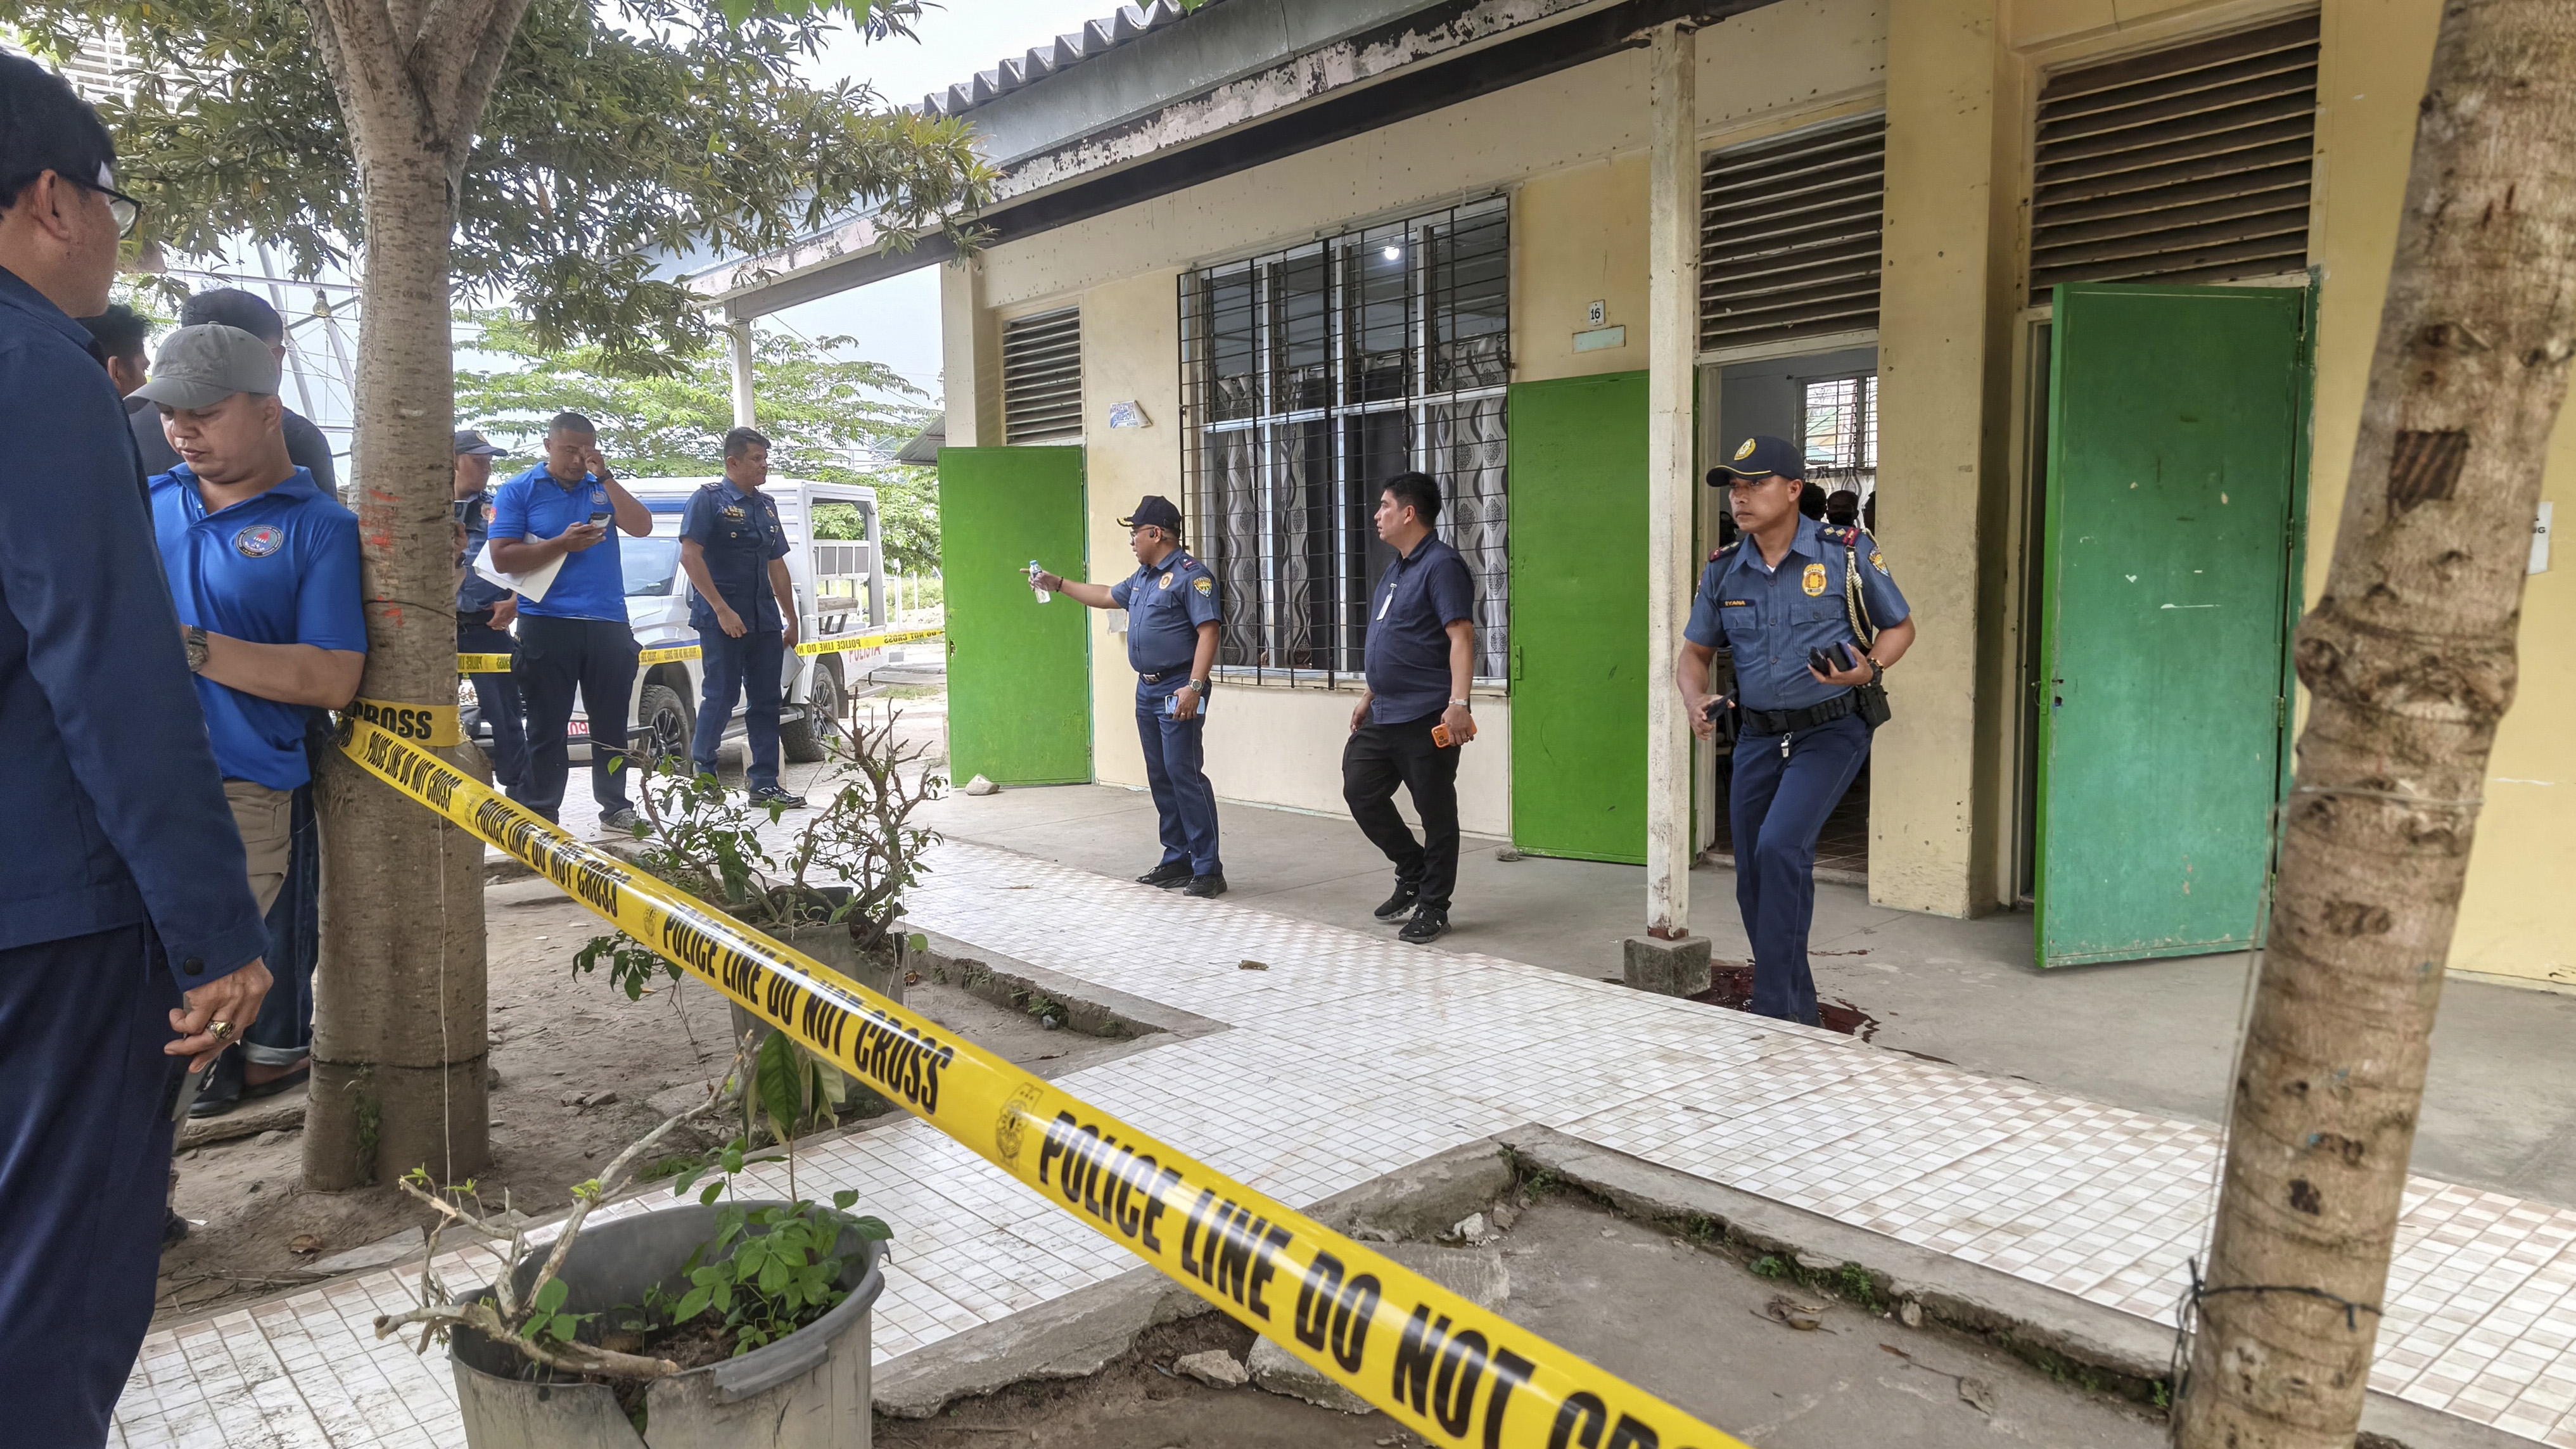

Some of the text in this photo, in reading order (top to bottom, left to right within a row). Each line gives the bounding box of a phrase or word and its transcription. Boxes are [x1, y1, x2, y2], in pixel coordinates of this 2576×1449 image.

[1591, 308, 1600, 320] 16
[364, 731, 393, 770] POLICE
[385, 743, 409, 779] LINE
[399, 751, 419, 786] DO
[411, 758, 436, 796] NOT
[426, 768, 463, 812] CROSS
[475, 798, 520, 846] POLICE
[508, 817, 543, 861] LINE
[577, 859, 632, 918] CROSS
[663, 903, 954, 1116] POLICE LINE DO NOT CROSS
[1038, 1109, 1183, 1256] POLICE
[1180, 1187, 1294, 1323] LINE
[1294, 1248, 1382, 1376] DO
[1393, 1301, 1538, 1449] NOT
